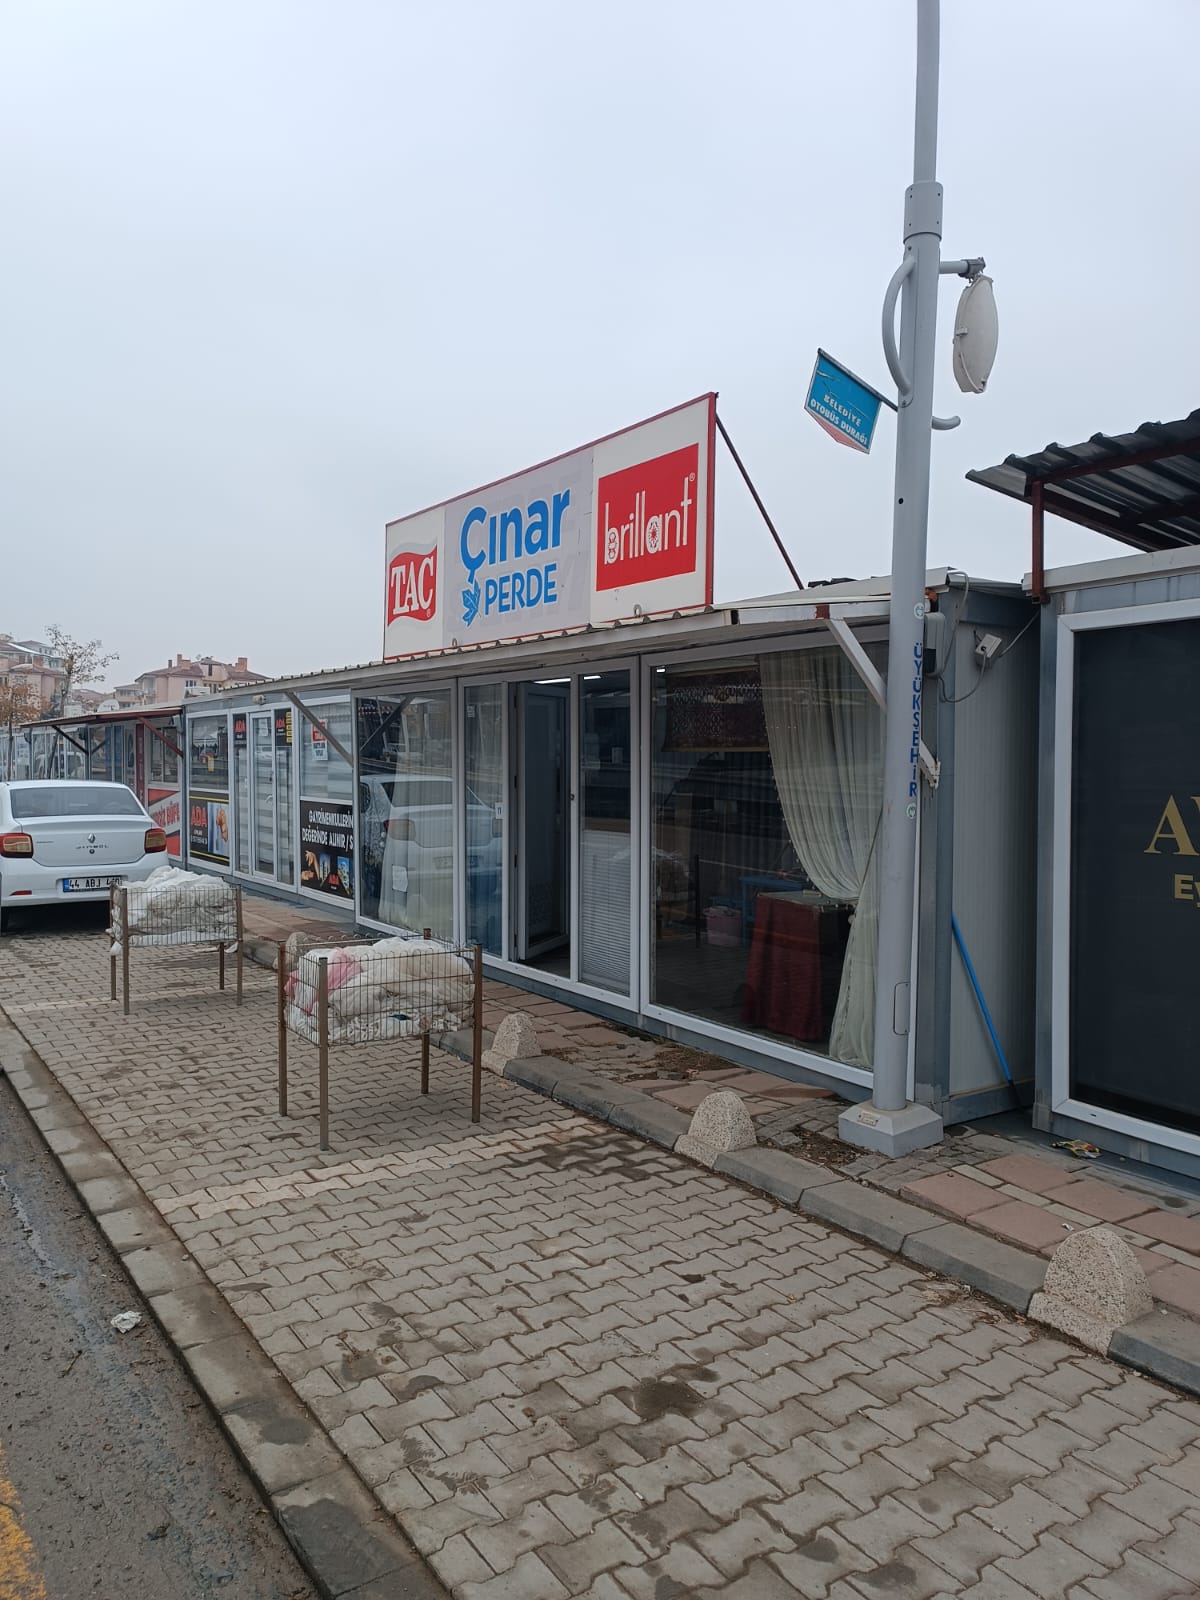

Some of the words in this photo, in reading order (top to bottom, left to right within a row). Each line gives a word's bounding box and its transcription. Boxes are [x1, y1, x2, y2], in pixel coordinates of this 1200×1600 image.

[810, 398, 840, 425] OTOBÜS
[840, 420, 868, 445] DURAĞI
[604, 476, 692, 565] brillant
[485, 563, 557, 616] PERDE
[191, 805, 208, 828] ADA
[69, 879, 80, 889] 44
[85, 878, 101, 888] ABJ
